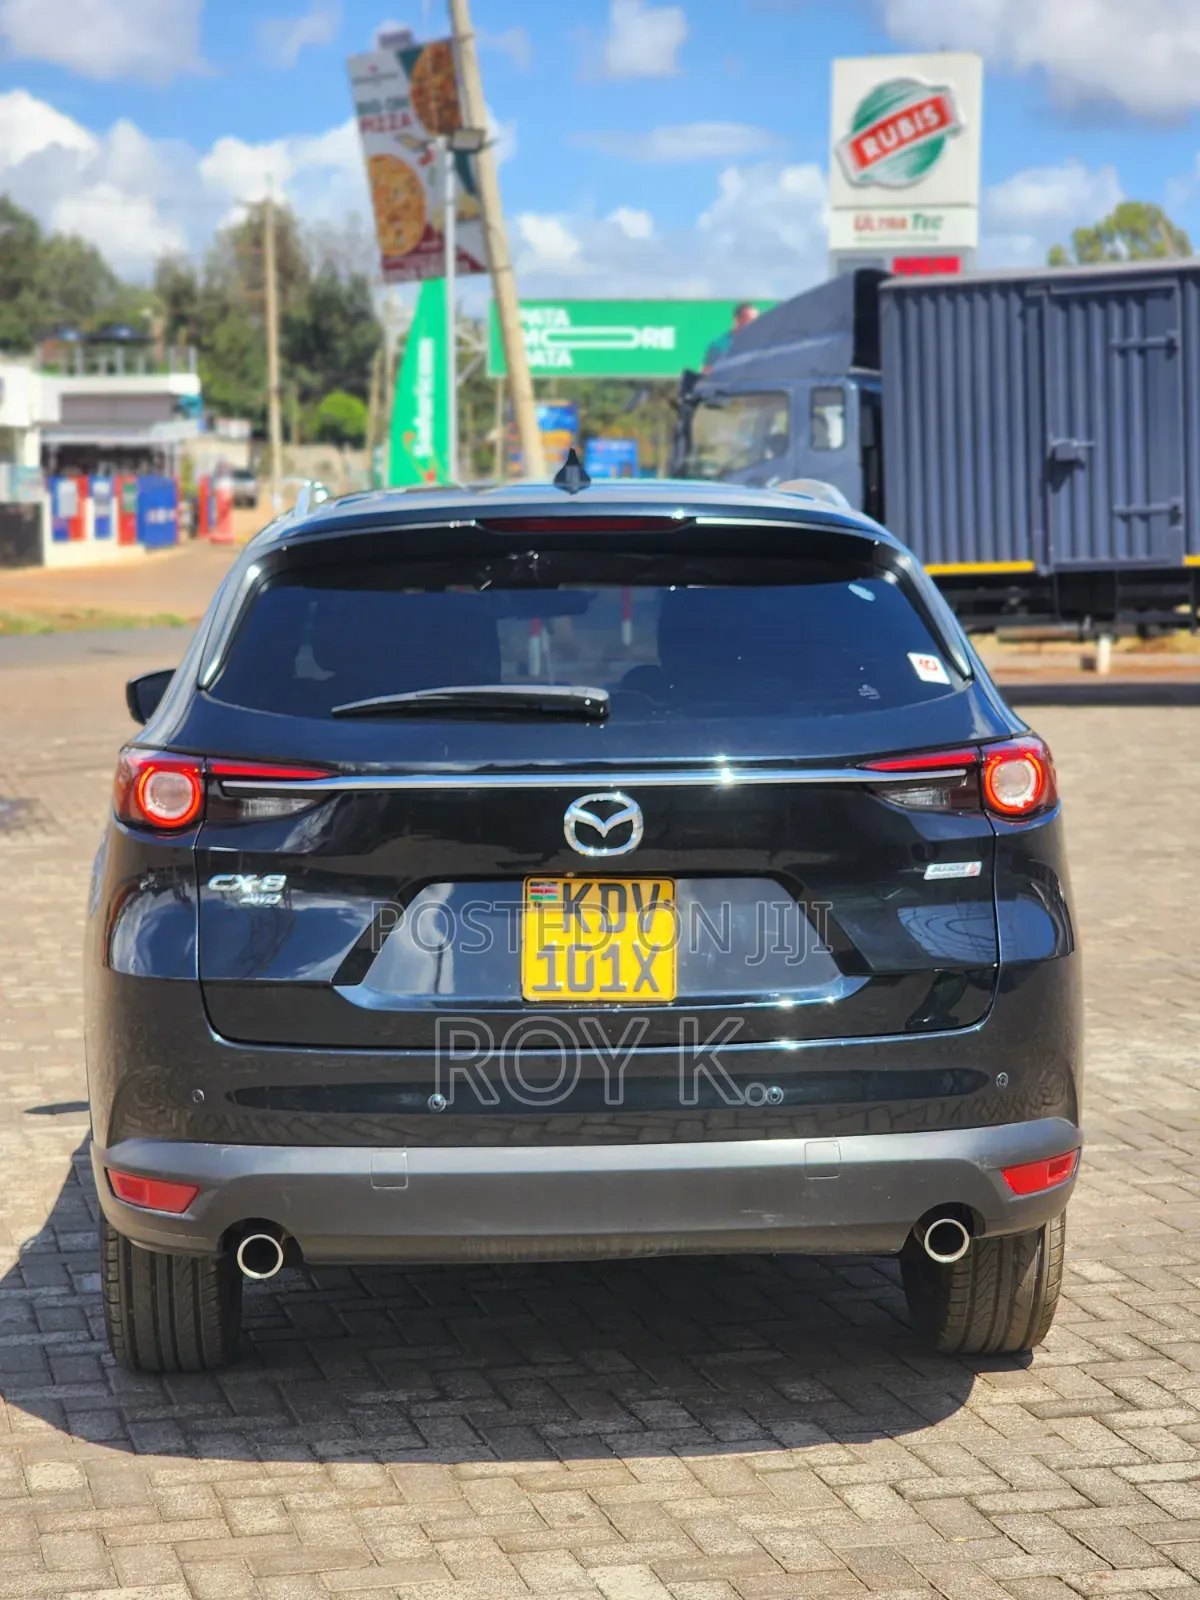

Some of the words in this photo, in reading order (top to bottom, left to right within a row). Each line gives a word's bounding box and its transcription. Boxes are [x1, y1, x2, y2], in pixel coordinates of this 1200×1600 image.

[859, 103, 941, 158] RUBIS
[526, 349, 575, 369] ATA
[561, 882, 661, 934] KDV
[531, 942, 661, 993] 101X
